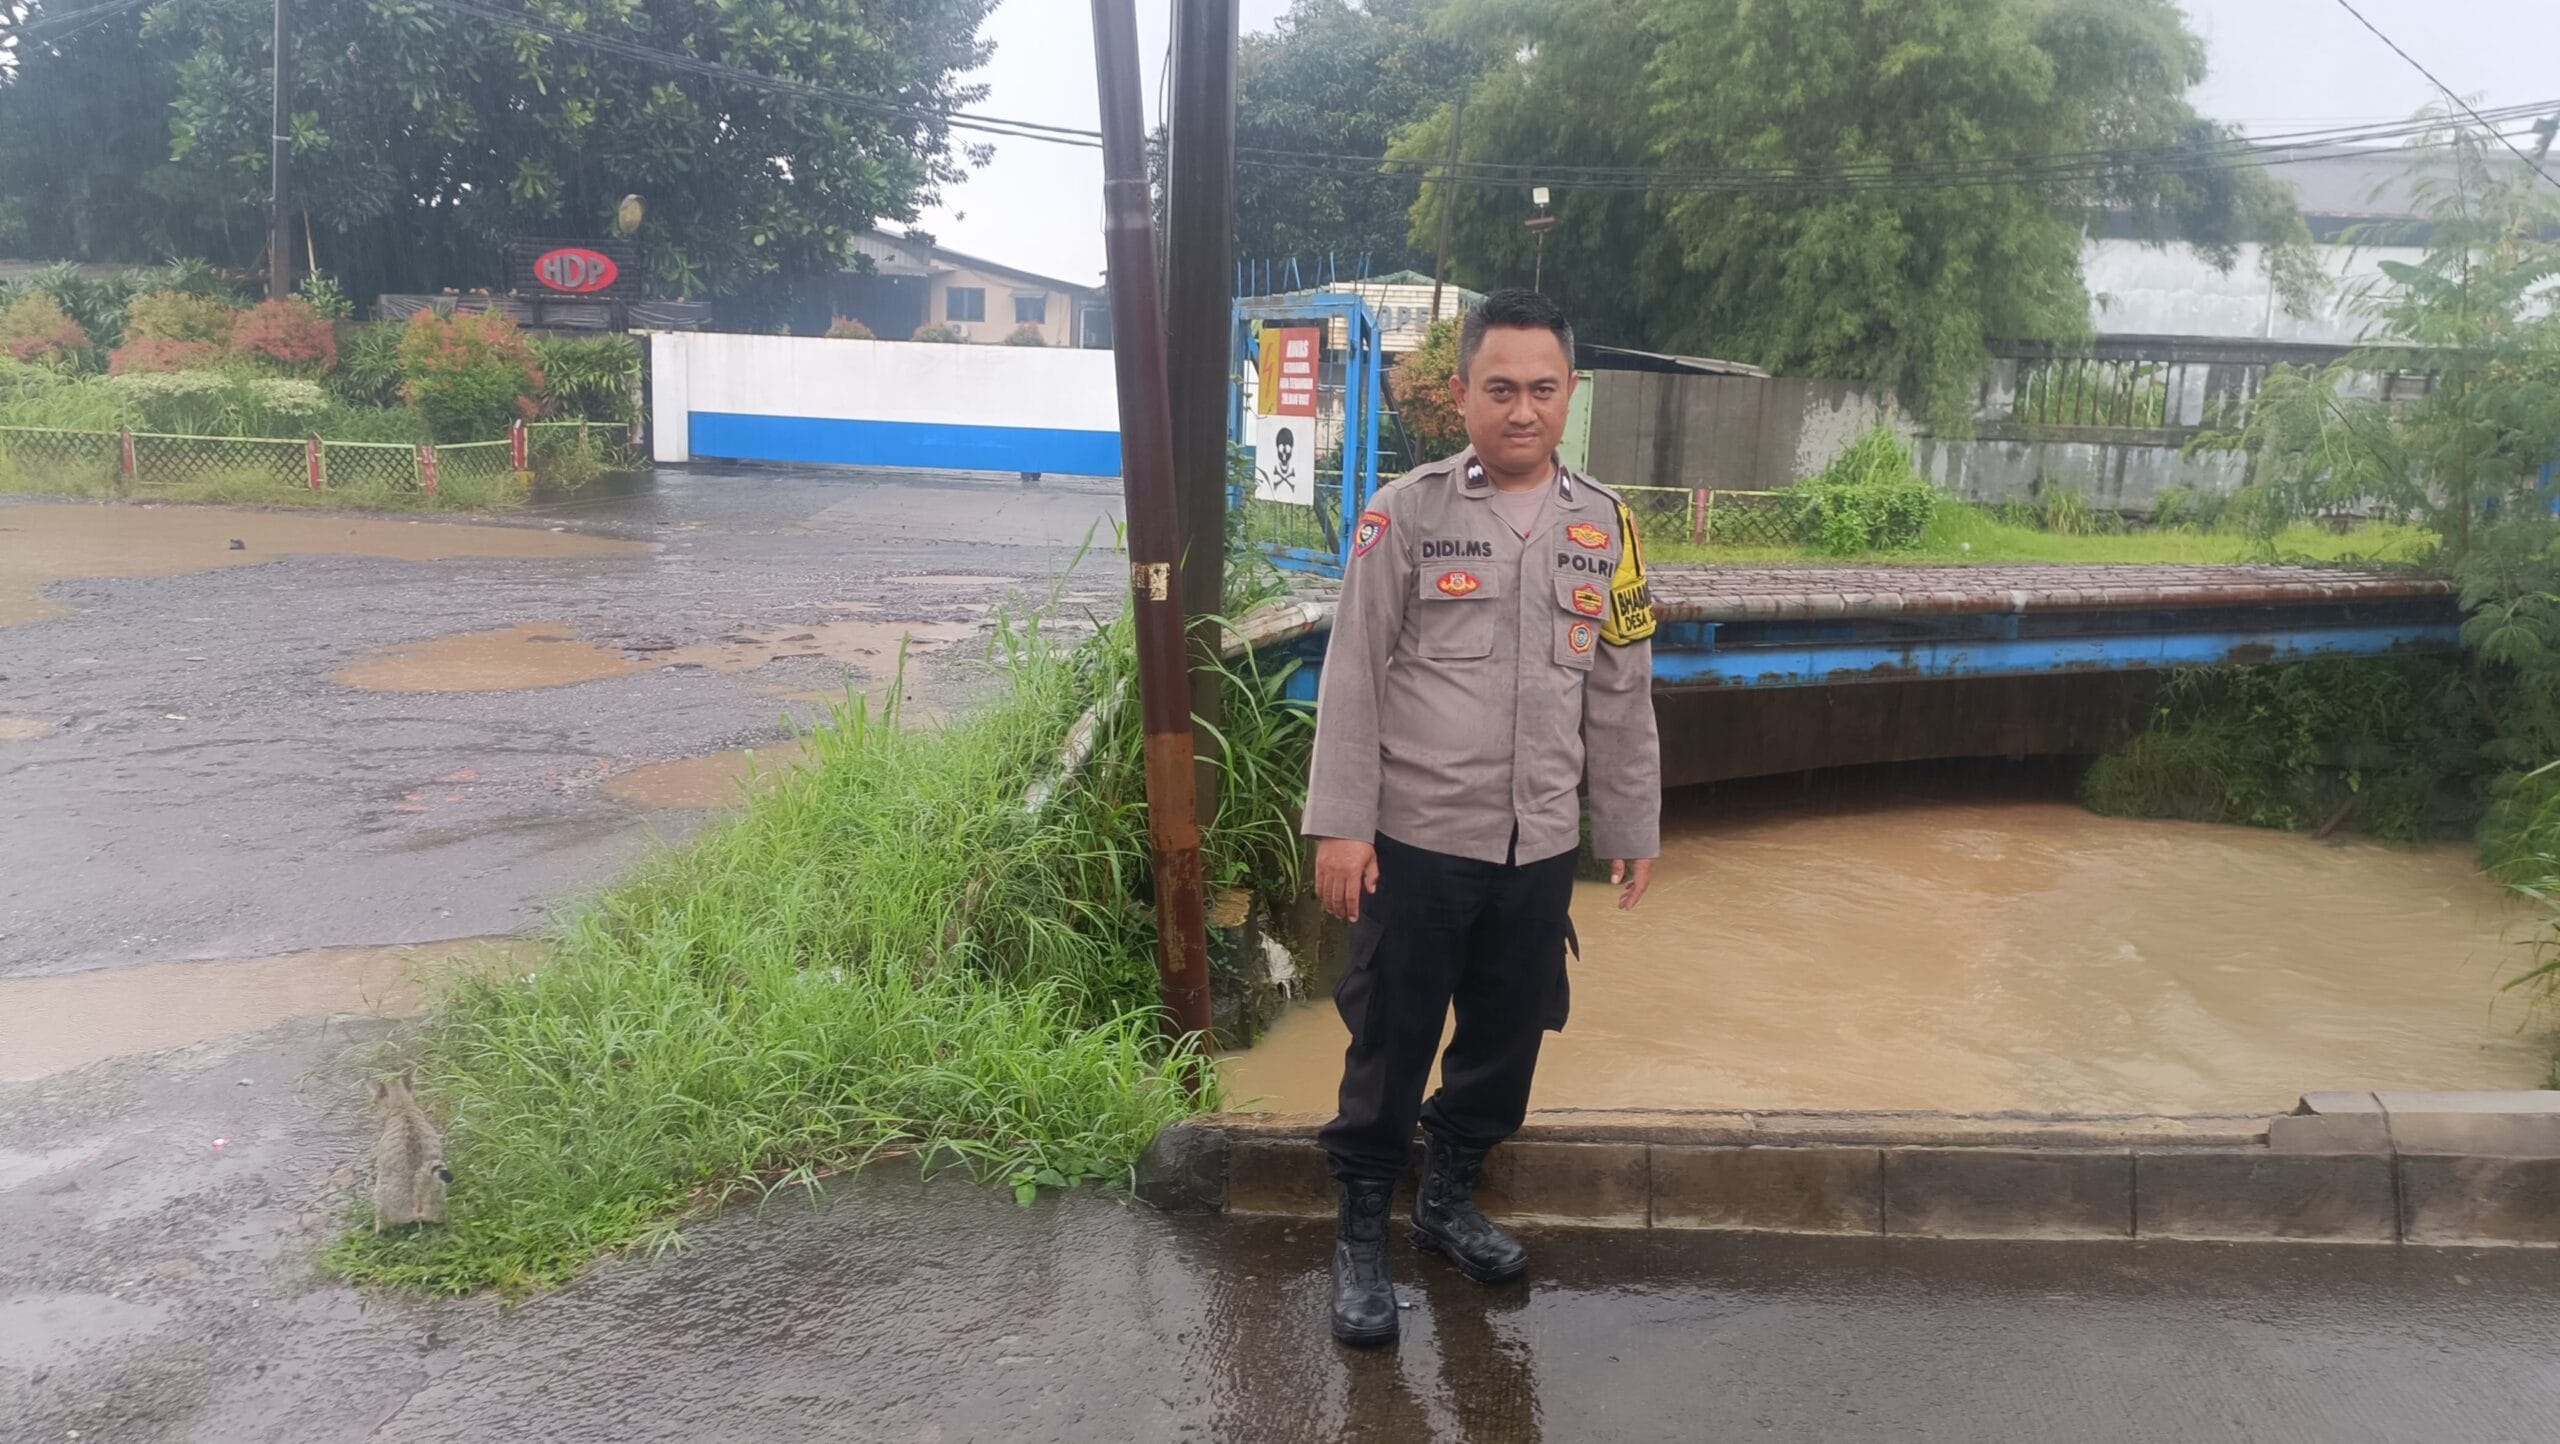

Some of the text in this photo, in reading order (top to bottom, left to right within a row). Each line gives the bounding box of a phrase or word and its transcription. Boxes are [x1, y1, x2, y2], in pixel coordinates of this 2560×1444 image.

[543, 254, 605, 288] HDP
[1422, 540, 1493, 558] DIDI.MS
[1557, 552, 1613, 578] POLRI
[1625, 610, 1648, 631] DESA
